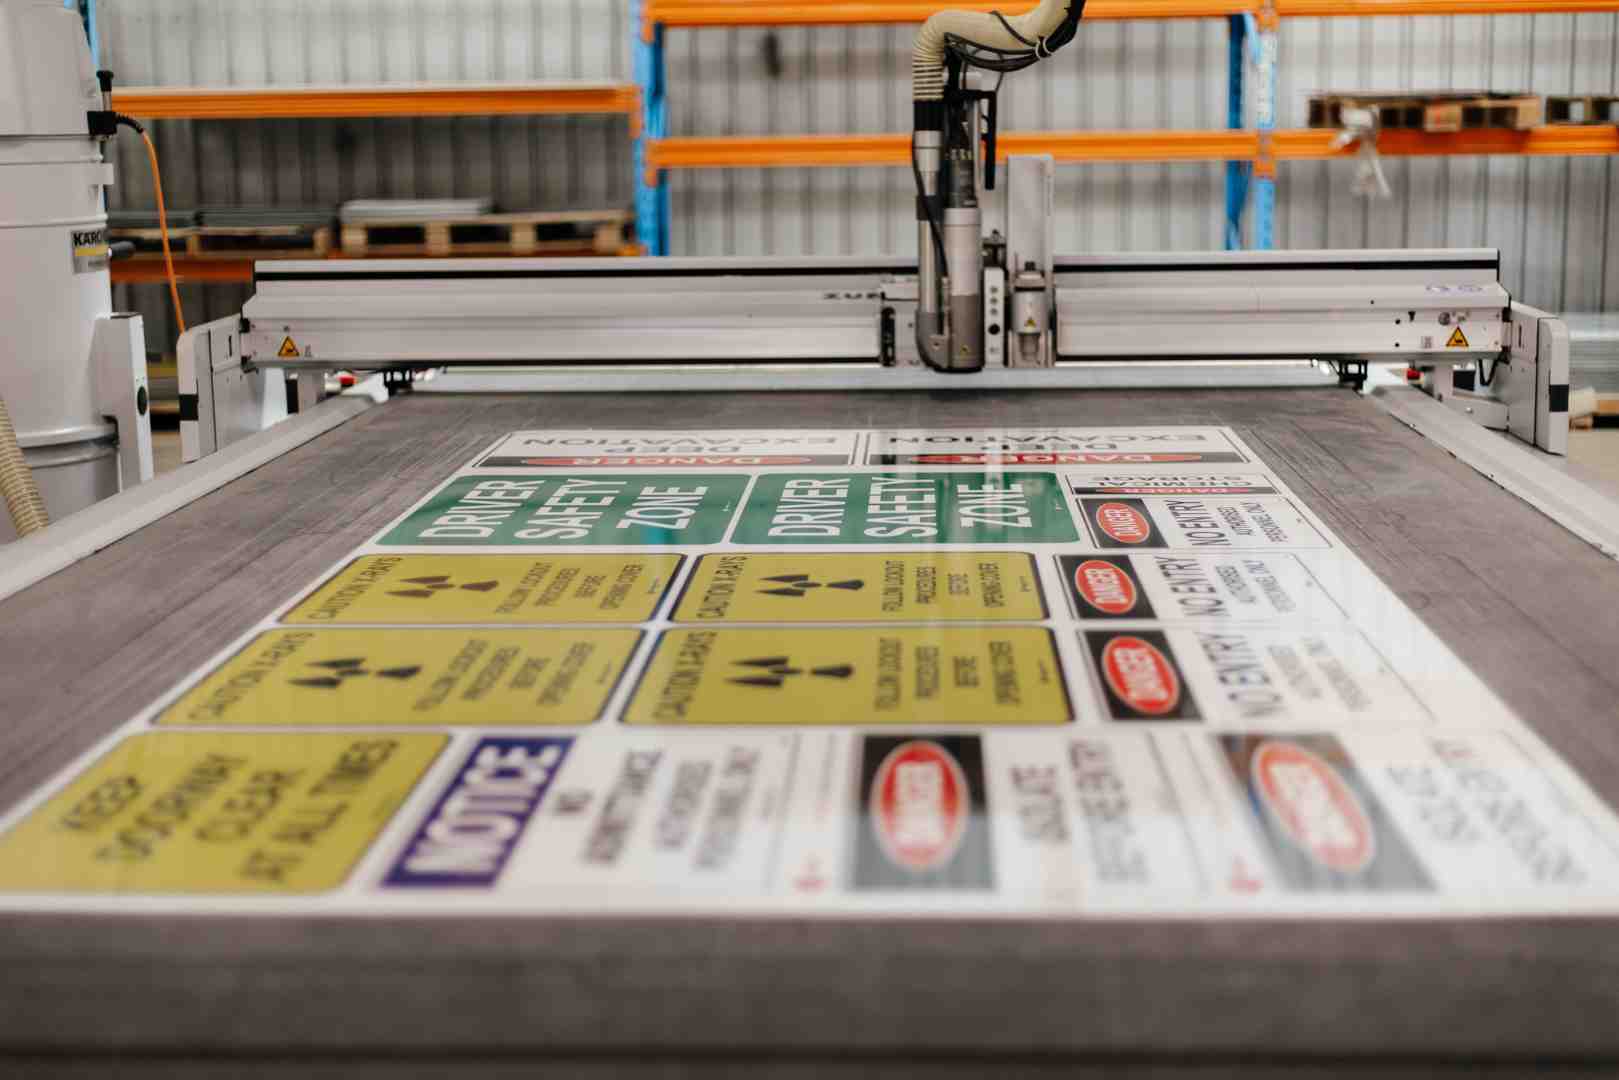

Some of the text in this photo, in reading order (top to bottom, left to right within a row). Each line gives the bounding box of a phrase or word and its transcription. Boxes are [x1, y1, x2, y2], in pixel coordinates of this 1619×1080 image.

[522, 437, 837, 446] EXCAVATION
[573, 457, 761, 465] DANGER
[603, 445, 741, 453] DEEP
[888, 434, 1208, 443] EXCAVATION
[958, 454, 1152, 462] DANGER
[418, 480, 547, 538] DRIVER
[513, 478, 628, 540] SAFETY
[616, 486, 709, 530] ZONE
[767, 478, 851, 537] DRIVER
[864, 476, 938, 538] SAFETY
[957, 483, 1033, 528] ZONE
[1103, 508, 1142, 536] DANGER
[1164, 499, 1232, 546] NO ENTRY
[306, 557, 404, 620] CAUTION X-RAYS
[696, 555, 748, 619] CAUTION X-RAYS
[1085, 568, 1129, 604] DANGER
[1155, 556, 1229, 616] NO ENTRY
[402, 744, 563, 873] NOTICE
